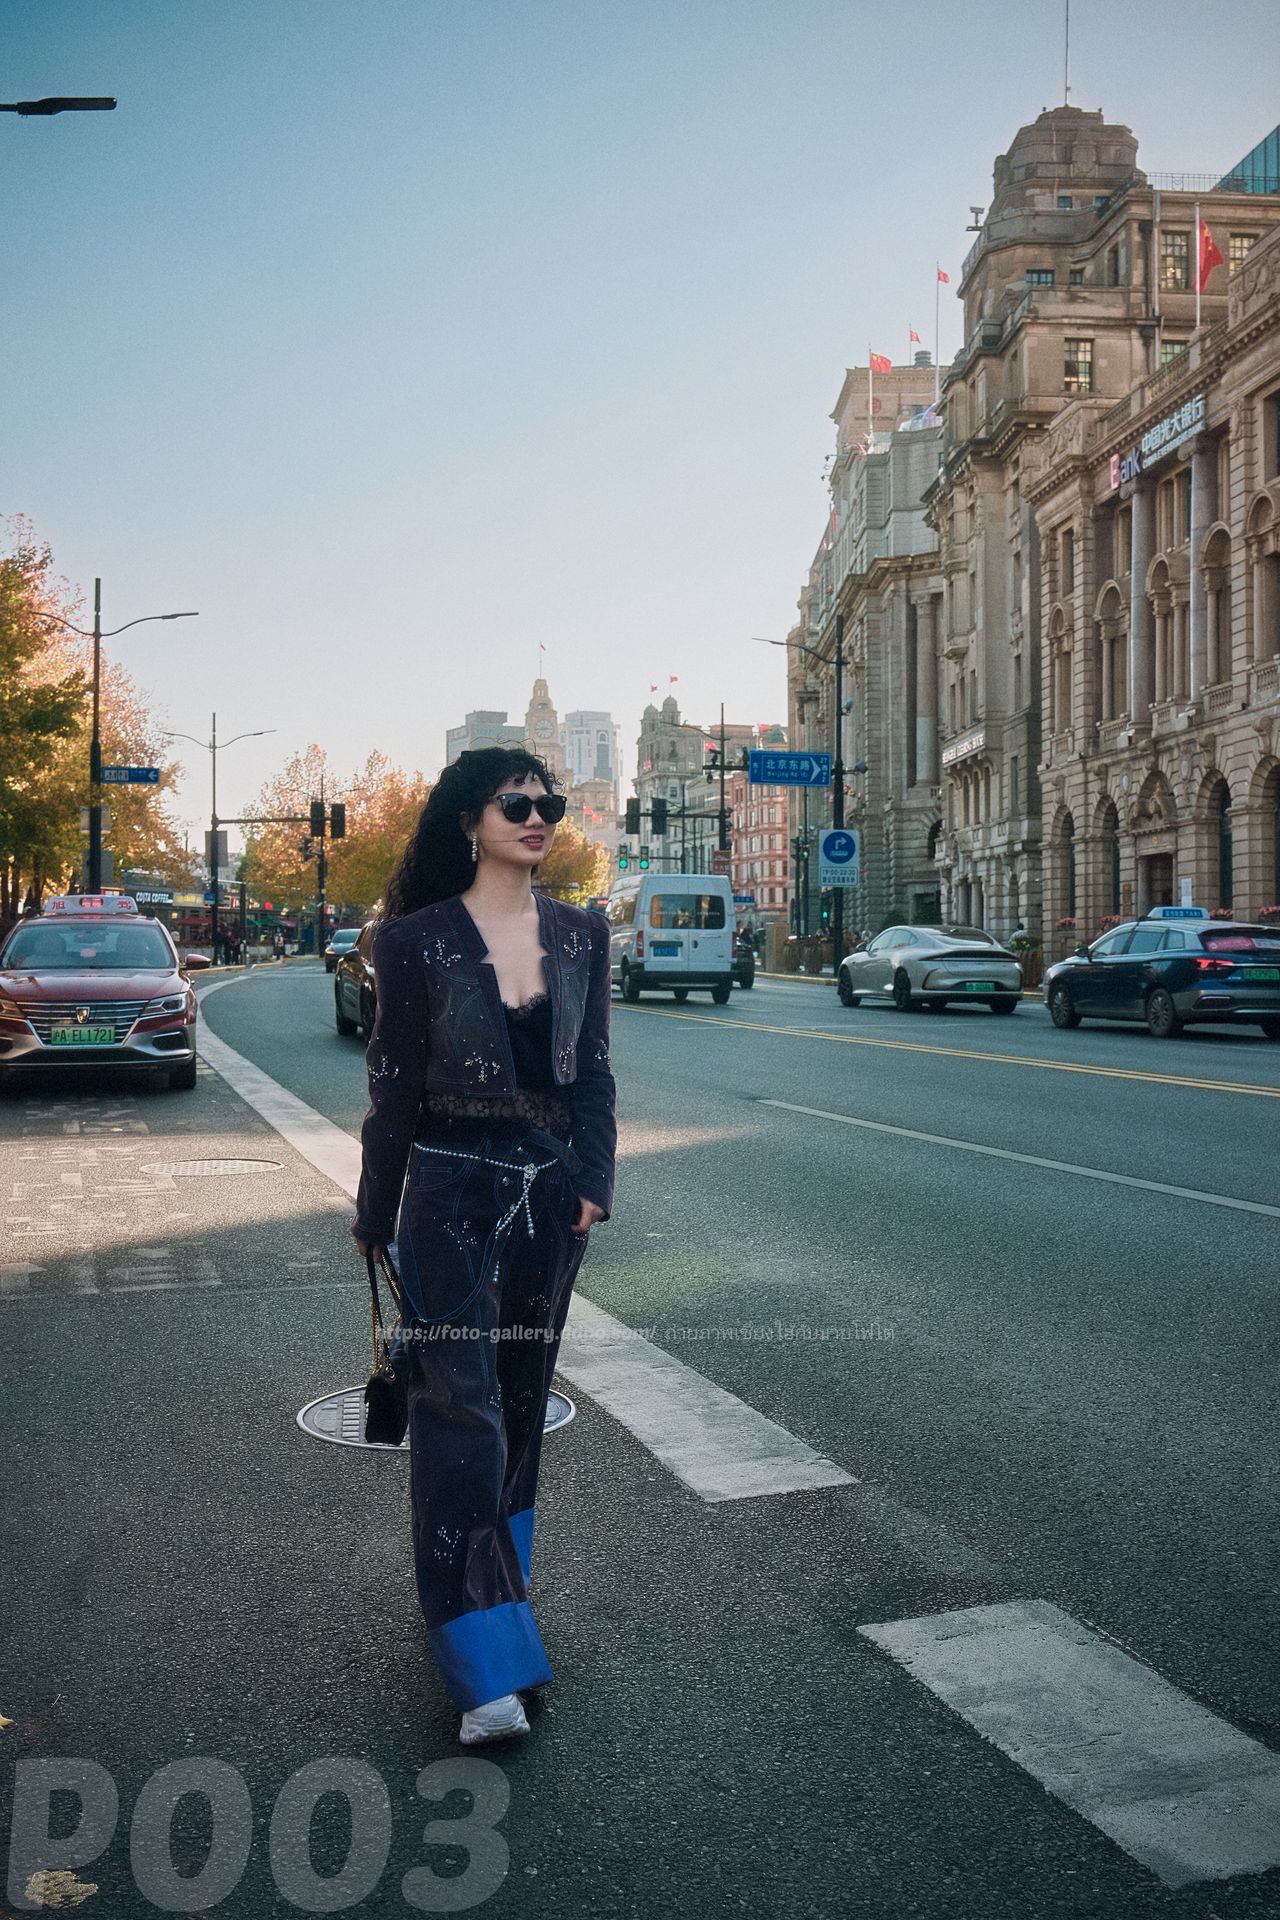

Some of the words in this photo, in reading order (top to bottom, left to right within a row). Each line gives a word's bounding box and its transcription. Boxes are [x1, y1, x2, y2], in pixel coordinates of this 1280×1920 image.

[1142, 393, 1206, 455] 中国光大银行
[766, 759, 810, 771] 北京东路
[136, 892, 151, 903] COSTA
[152, 893, 169, 903] COFFEE
[72, 1029, 112, 1041] EL1721
